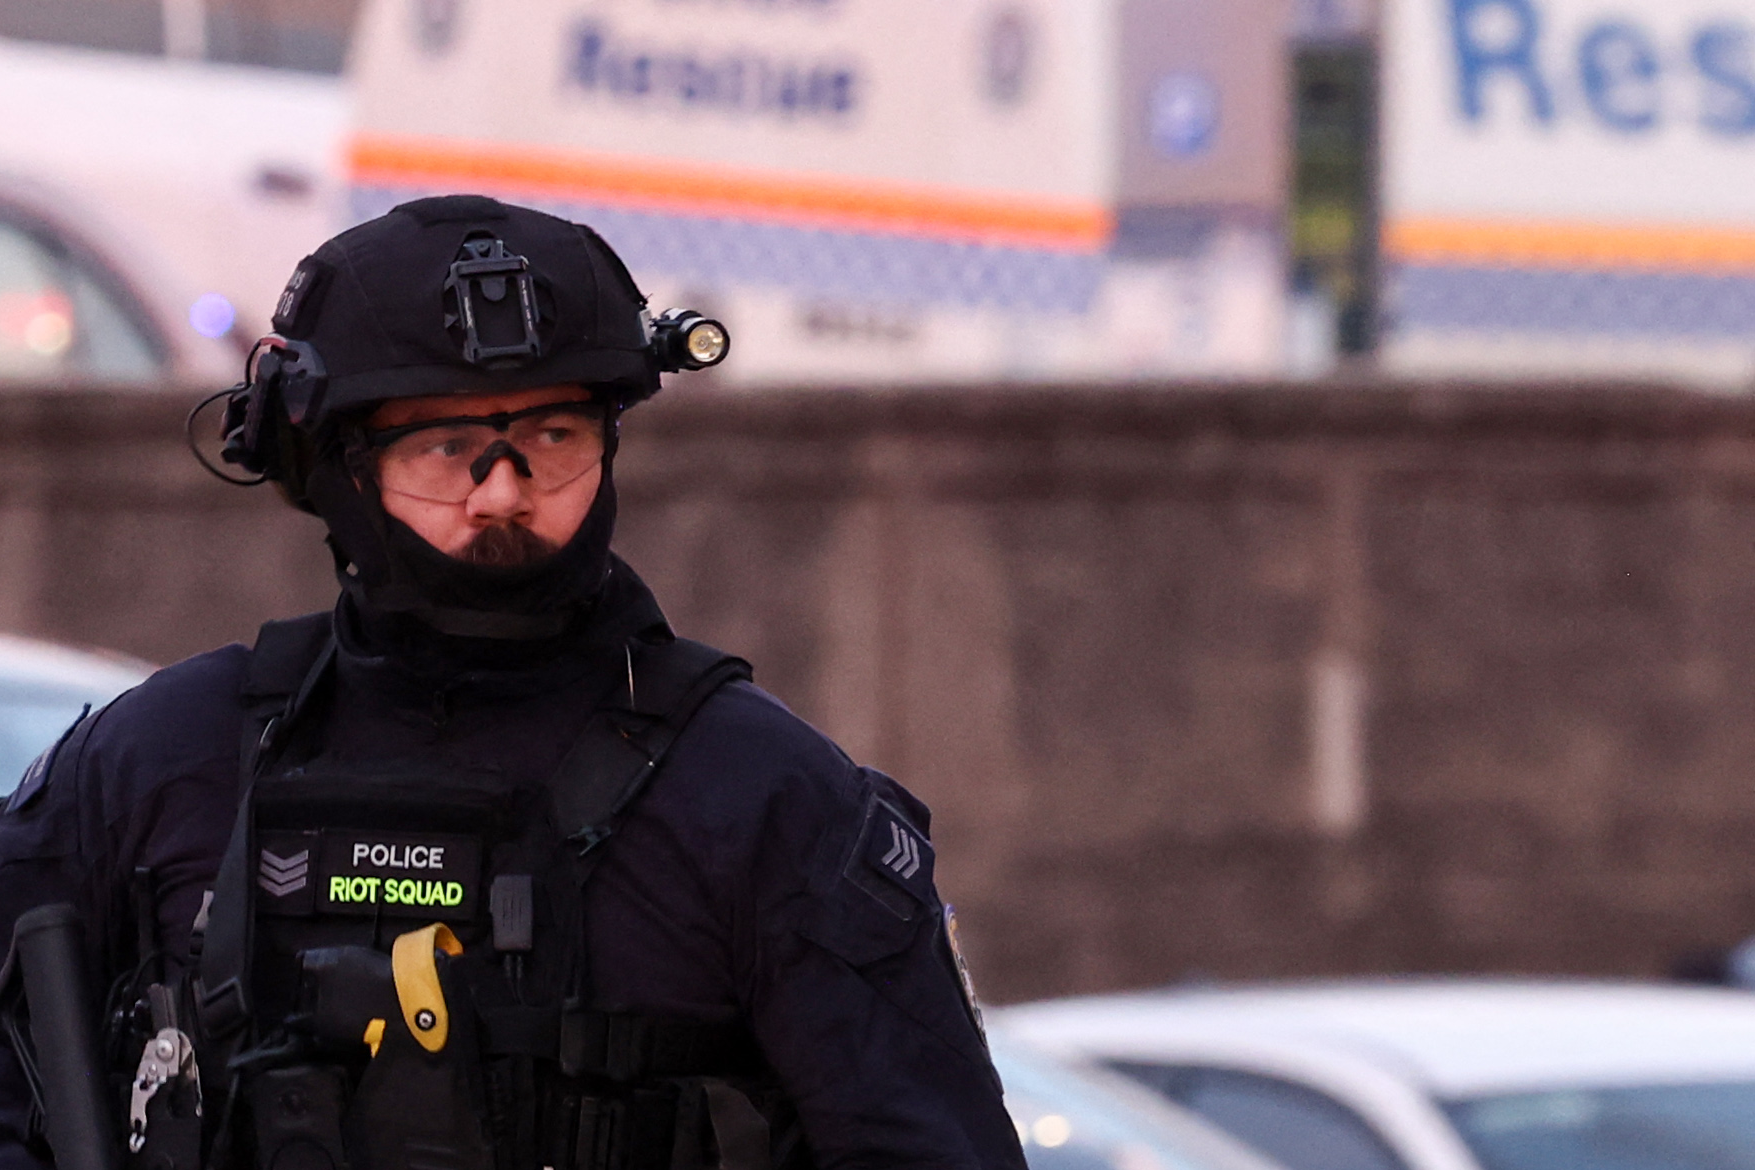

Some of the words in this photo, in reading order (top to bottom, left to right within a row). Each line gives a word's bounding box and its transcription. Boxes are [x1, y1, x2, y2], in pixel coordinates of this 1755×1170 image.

[353, 843, 445, 869] POLICE
[329, 876, 381, 903] RIOT
[384, 878, 463, 906] SQUAD
